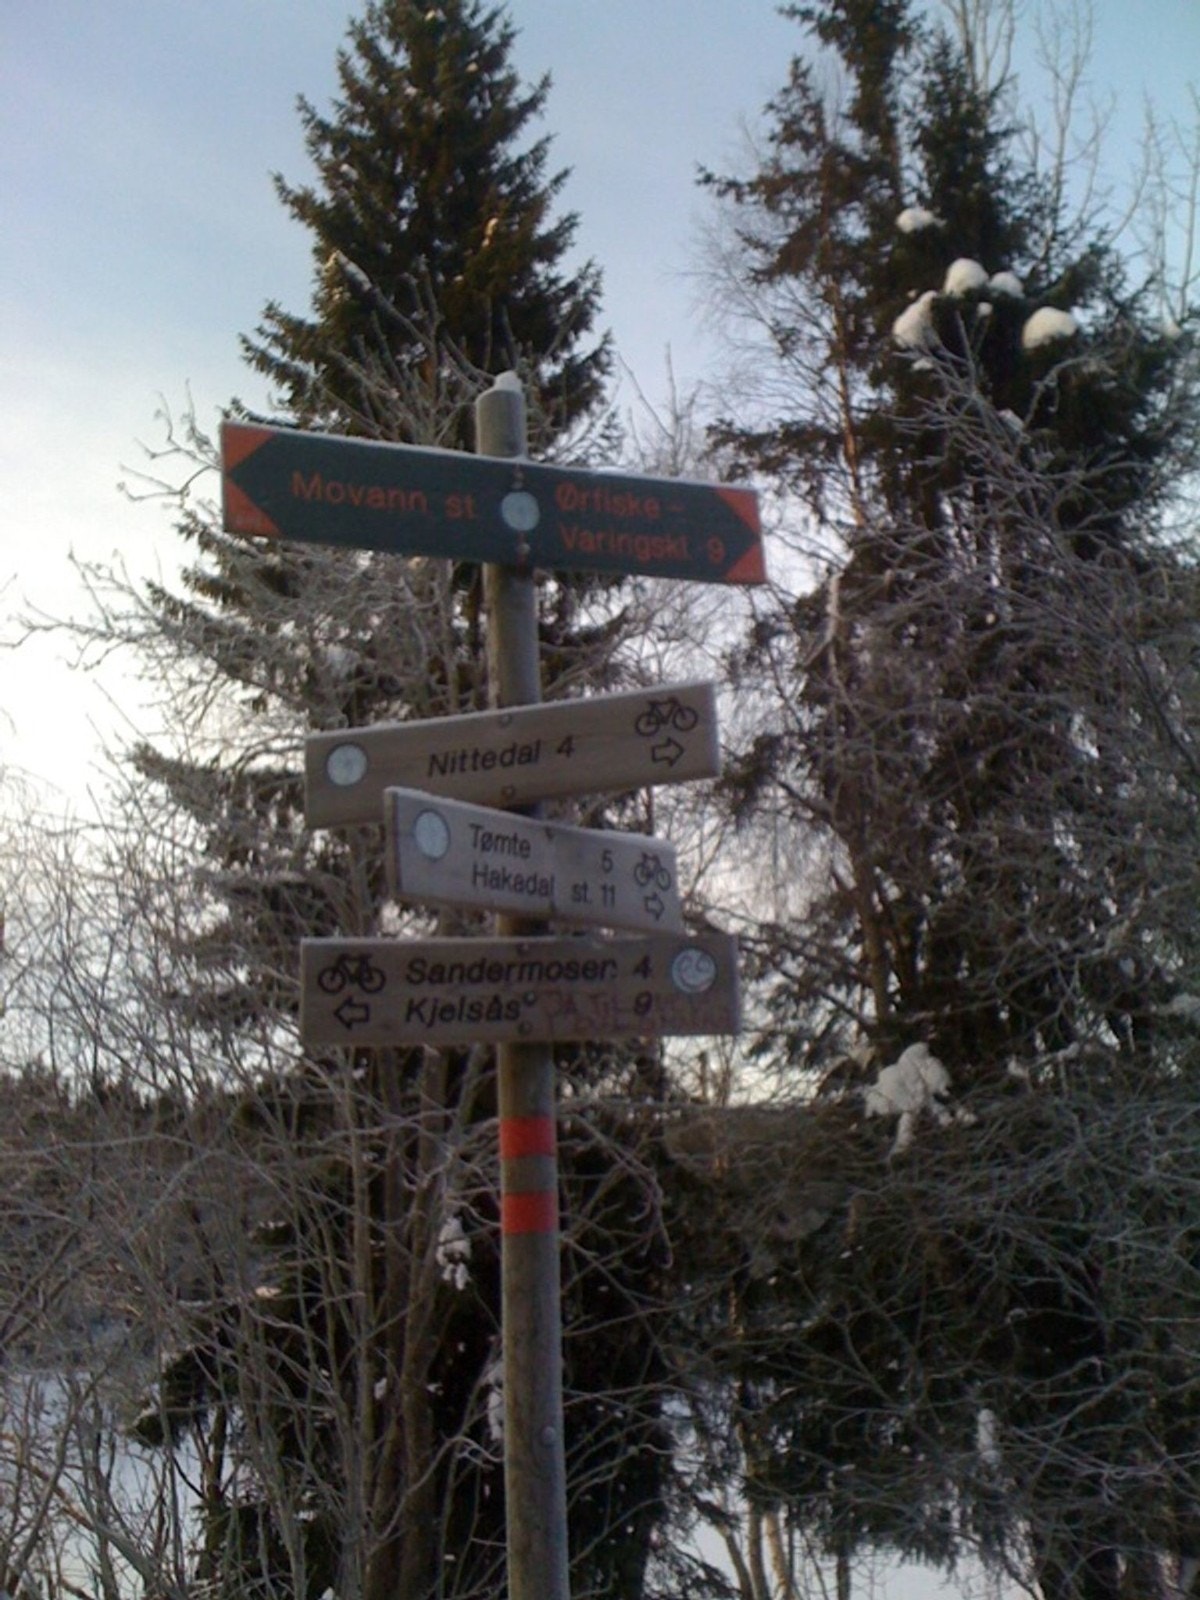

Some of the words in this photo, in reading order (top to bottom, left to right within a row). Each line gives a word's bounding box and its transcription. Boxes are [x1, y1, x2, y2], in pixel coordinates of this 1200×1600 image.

[291, 470, 429, 515] Movann
[444, 492, 475, 520] st
[707, 537, 725, 564] 9
[428, 739, 541, 777] Nittedal
[557, 735, 575, 758] 4
[469, 823, 531, 859] Tømte
[602, 850, 614, 873] 5
[472, 863, 555, 898] Hakadal
[602, 883, 616, 907] 11
[633, 957, 651, 979] 4
[405, 995, 521, 1028] Kjelsås
[633, 991, 652, 1015] 9
